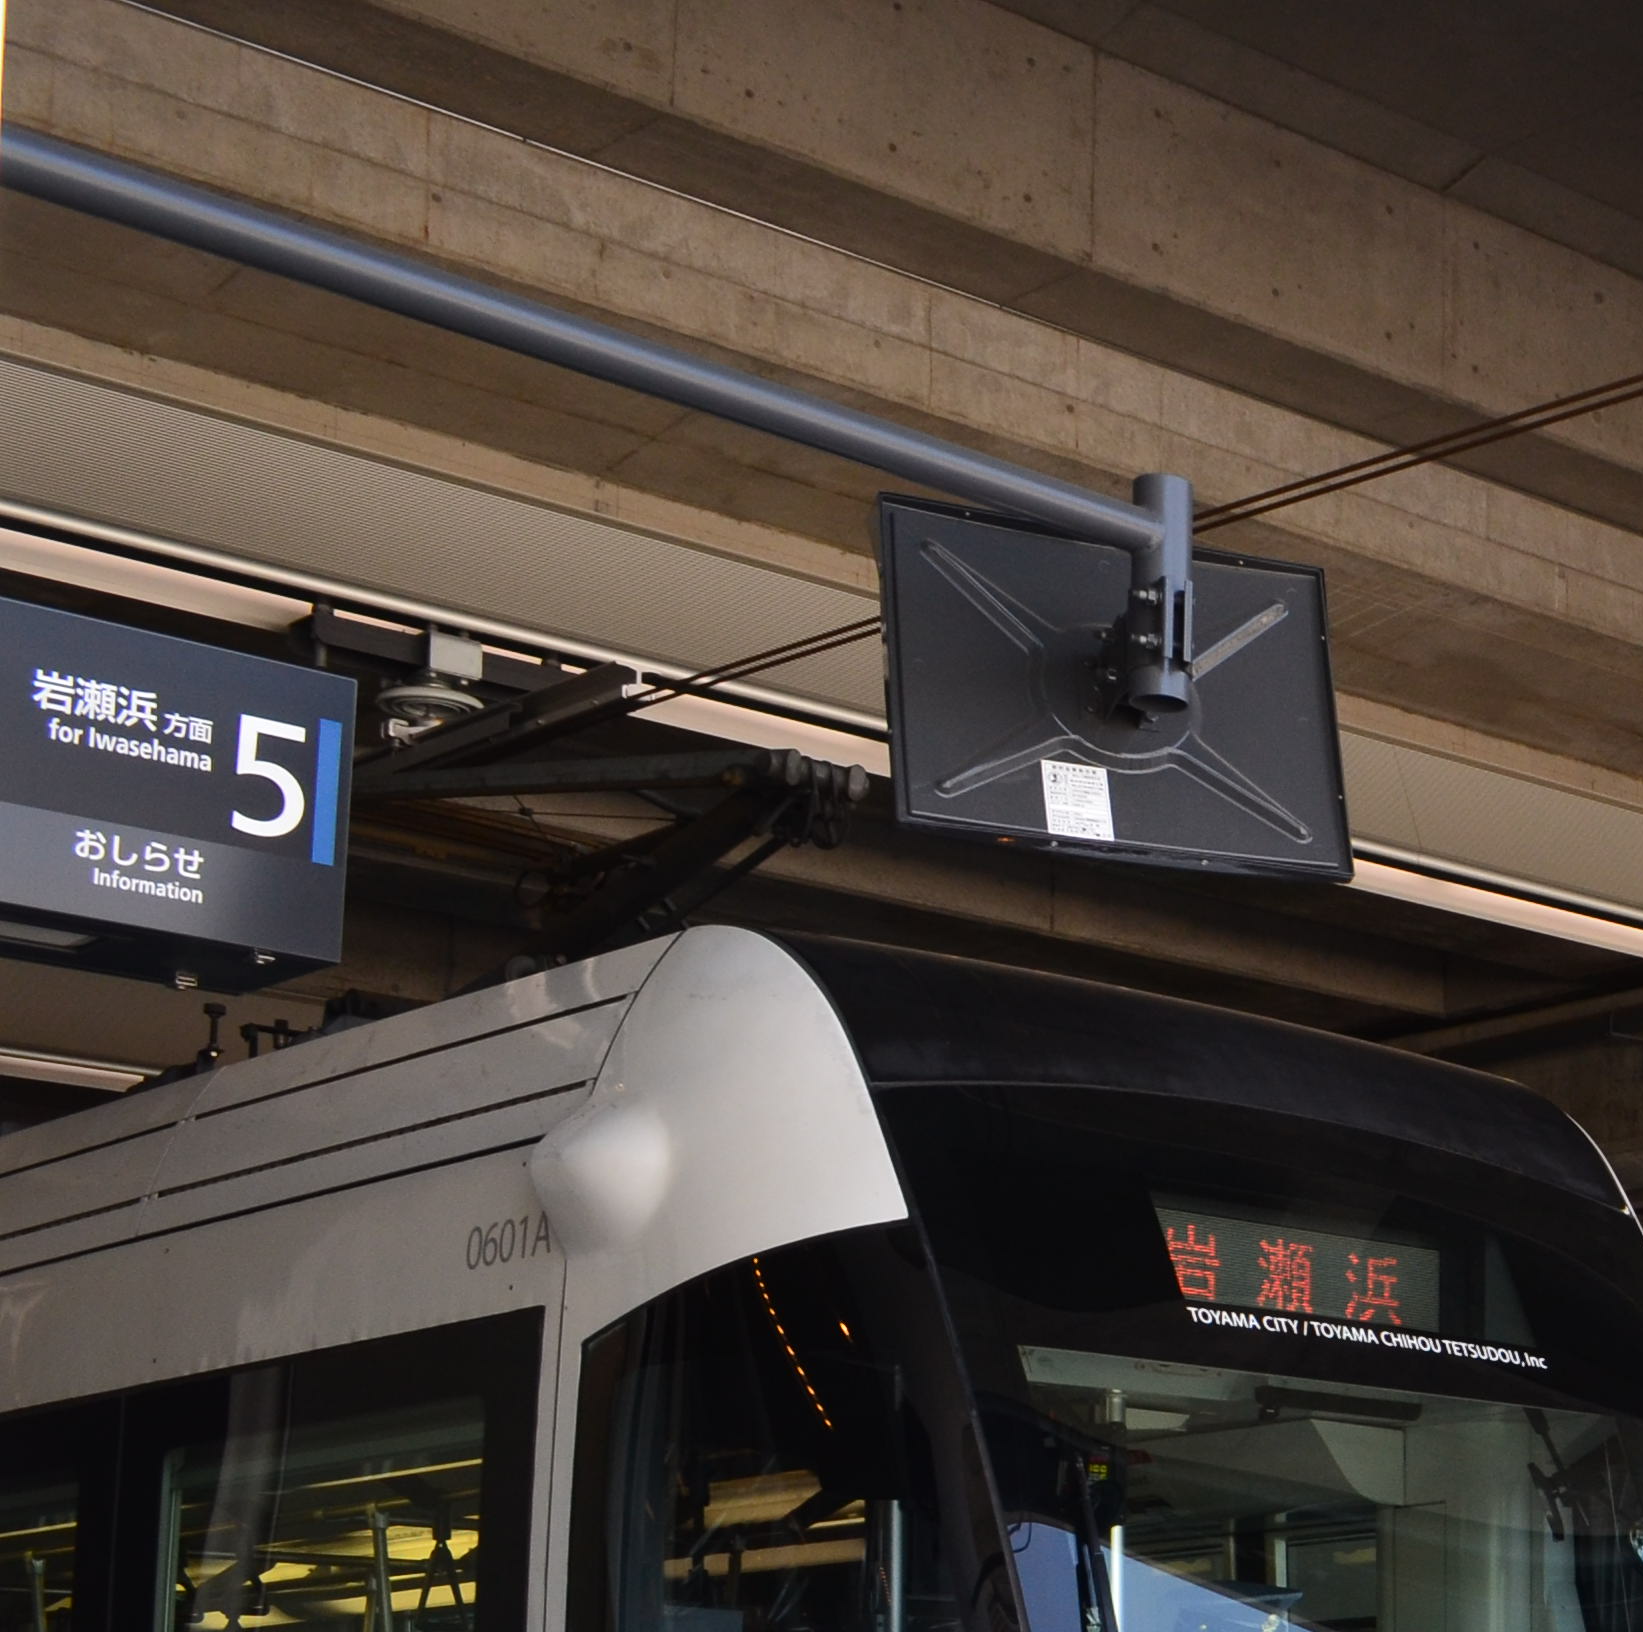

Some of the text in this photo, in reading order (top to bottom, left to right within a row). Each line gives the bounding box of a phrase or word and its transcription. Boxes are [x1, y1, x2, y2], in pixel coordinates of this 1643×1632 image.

[33, 668, 214, 744] 岩瀬浜 方面
[48, 717, 213, 772] for Iwasehama
[231, 713, 306, 838] 5
[74, 828, 205, 880] おしらせ
[93, 867, 204, 904] Information
[466, 1209, 552, 1270] 0601A
[1166, 1224, 1403, 1325] 岩瀬浜
[1186, 1306, 1261, 1331] TOYAMA
[1262, 1316, 1300, 1336] CITY
[1310, 1322, 1379, 1345] TOYAMA
[1380, 1332, 1442, 1354] CHIHOU
